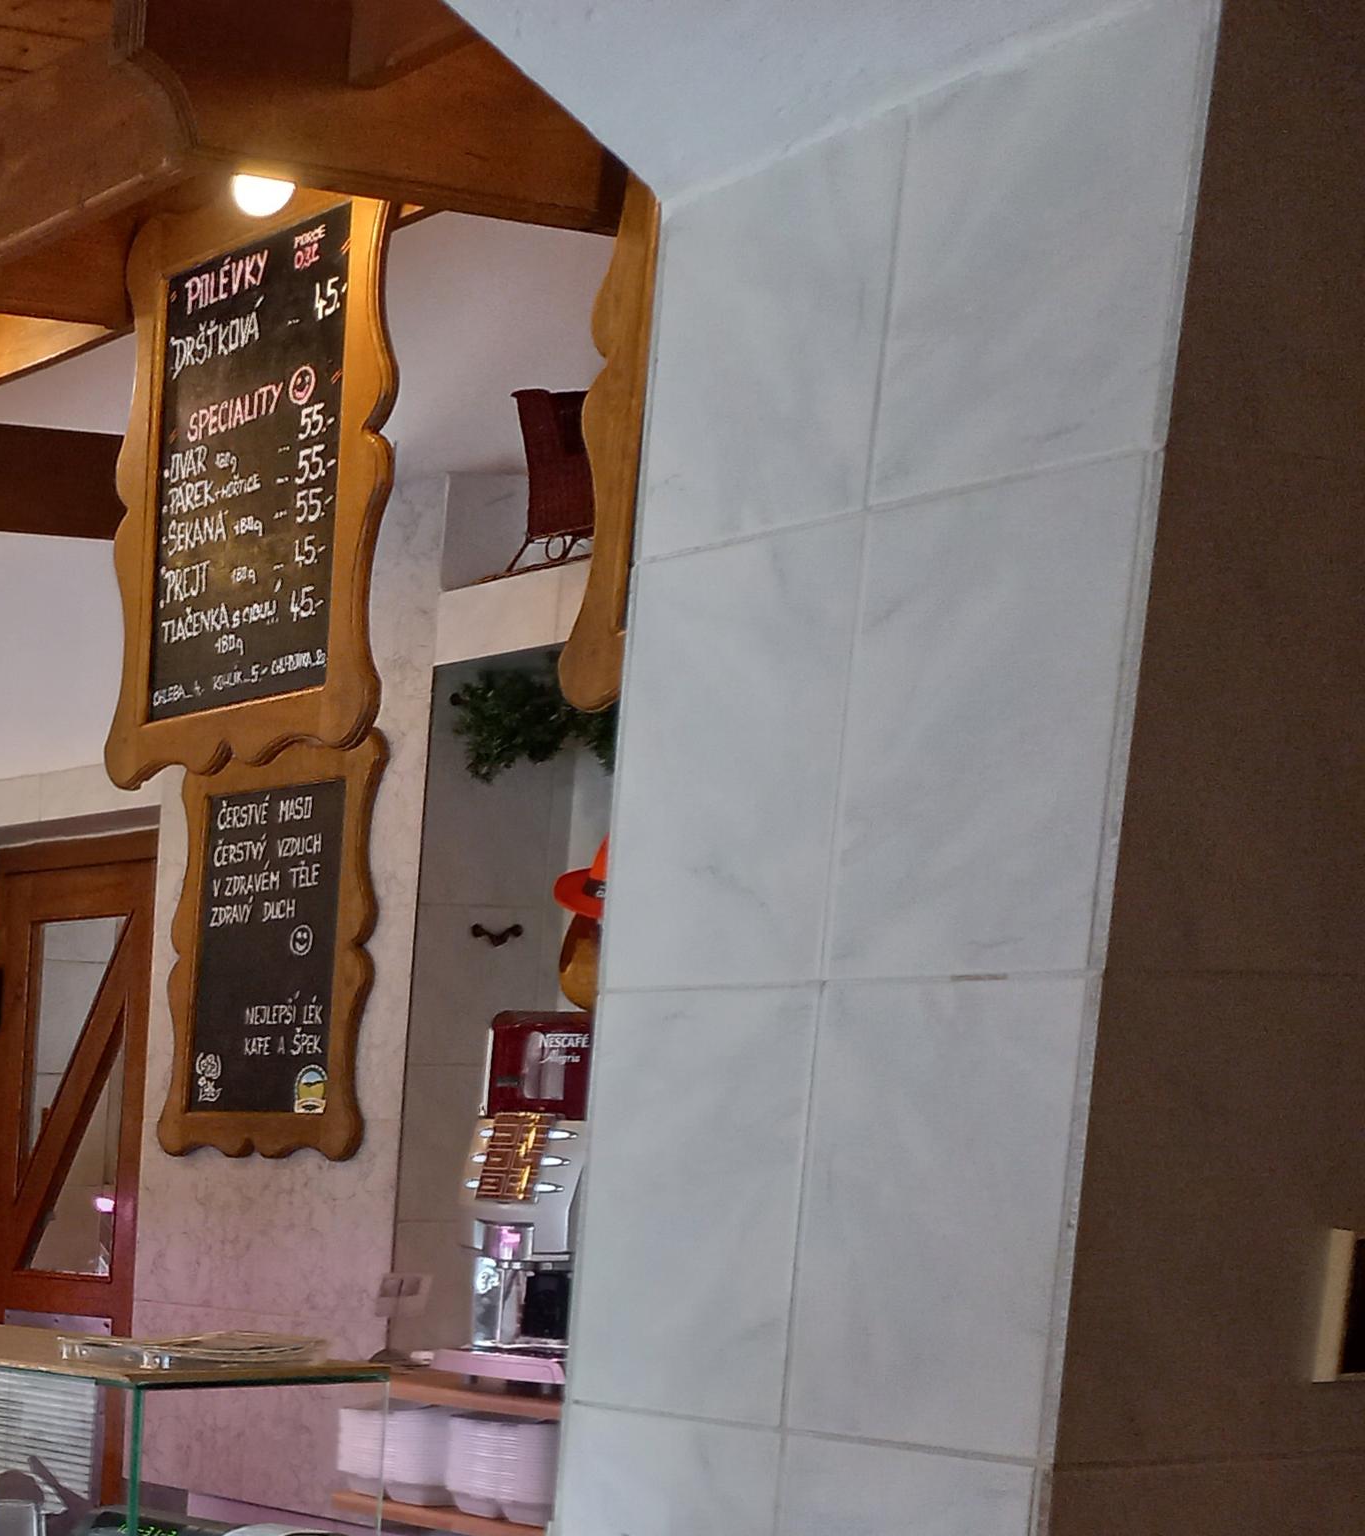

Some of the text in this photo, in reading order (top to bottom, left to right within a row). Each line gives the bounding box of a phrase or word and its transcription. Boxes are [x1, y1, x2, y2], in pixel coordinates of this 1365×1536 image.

[185, 250, 268, 315] POLÉVKY
[170, 295, 264, 380] DRŠŤKOVÁ
[187, 382, 284, 443] SPECIALITY
[170, 446, 207, 483] OVAR
[168, 479, 215, 516] PÁREK
[168, 509, 229, 557] SEKANÁ
[163, 560, 211, 604] PREJT
[217, 794, 312, 831] ČERSTVÉ MASO
[213, 833, 322, 867] ČERSTVÝ VZDUCH
[213, 860, 320, 897] V ZDRAVÉM TĚLE
[209, 896, 296, 928] ZDRAVÝ DUCH
[245, 990, 323, 1026] NEJLEPŠÍ LÉK
[244, 1028, 323, 1056] KAFE A ŠPEK
[539, 1033, 589, 1049] NESCAFÉ
